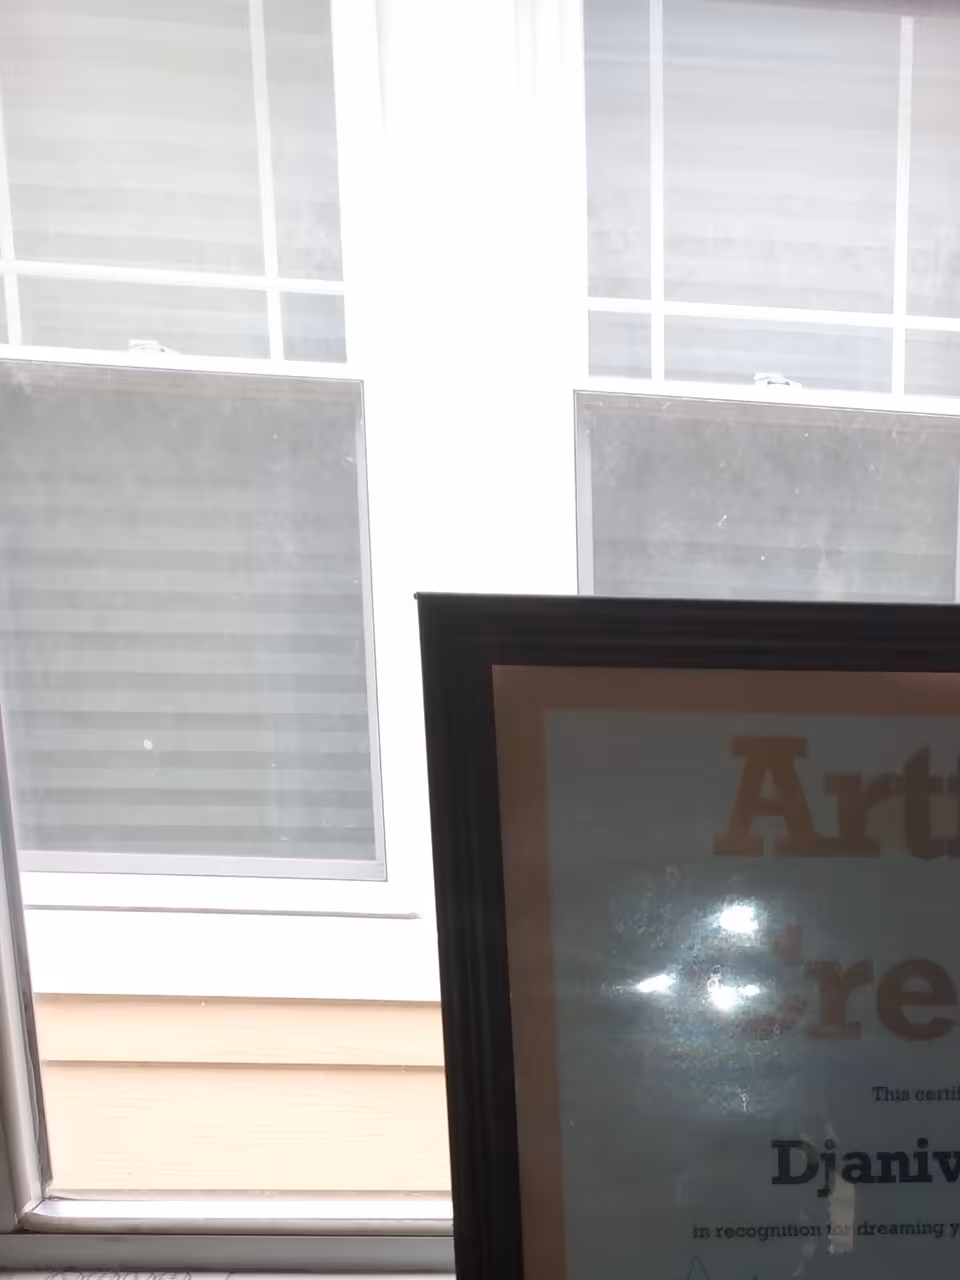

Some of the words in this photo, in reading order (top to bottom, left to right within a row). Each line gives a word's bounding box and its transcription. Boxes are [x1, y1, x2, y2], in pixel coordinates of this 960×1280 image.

[871, 1085, 910, 1101] This
[692, 1223, 711, 1239] in
[715, 1220, 822, 1242] recognition
[857, 1219, 943, 1239] dreaming
